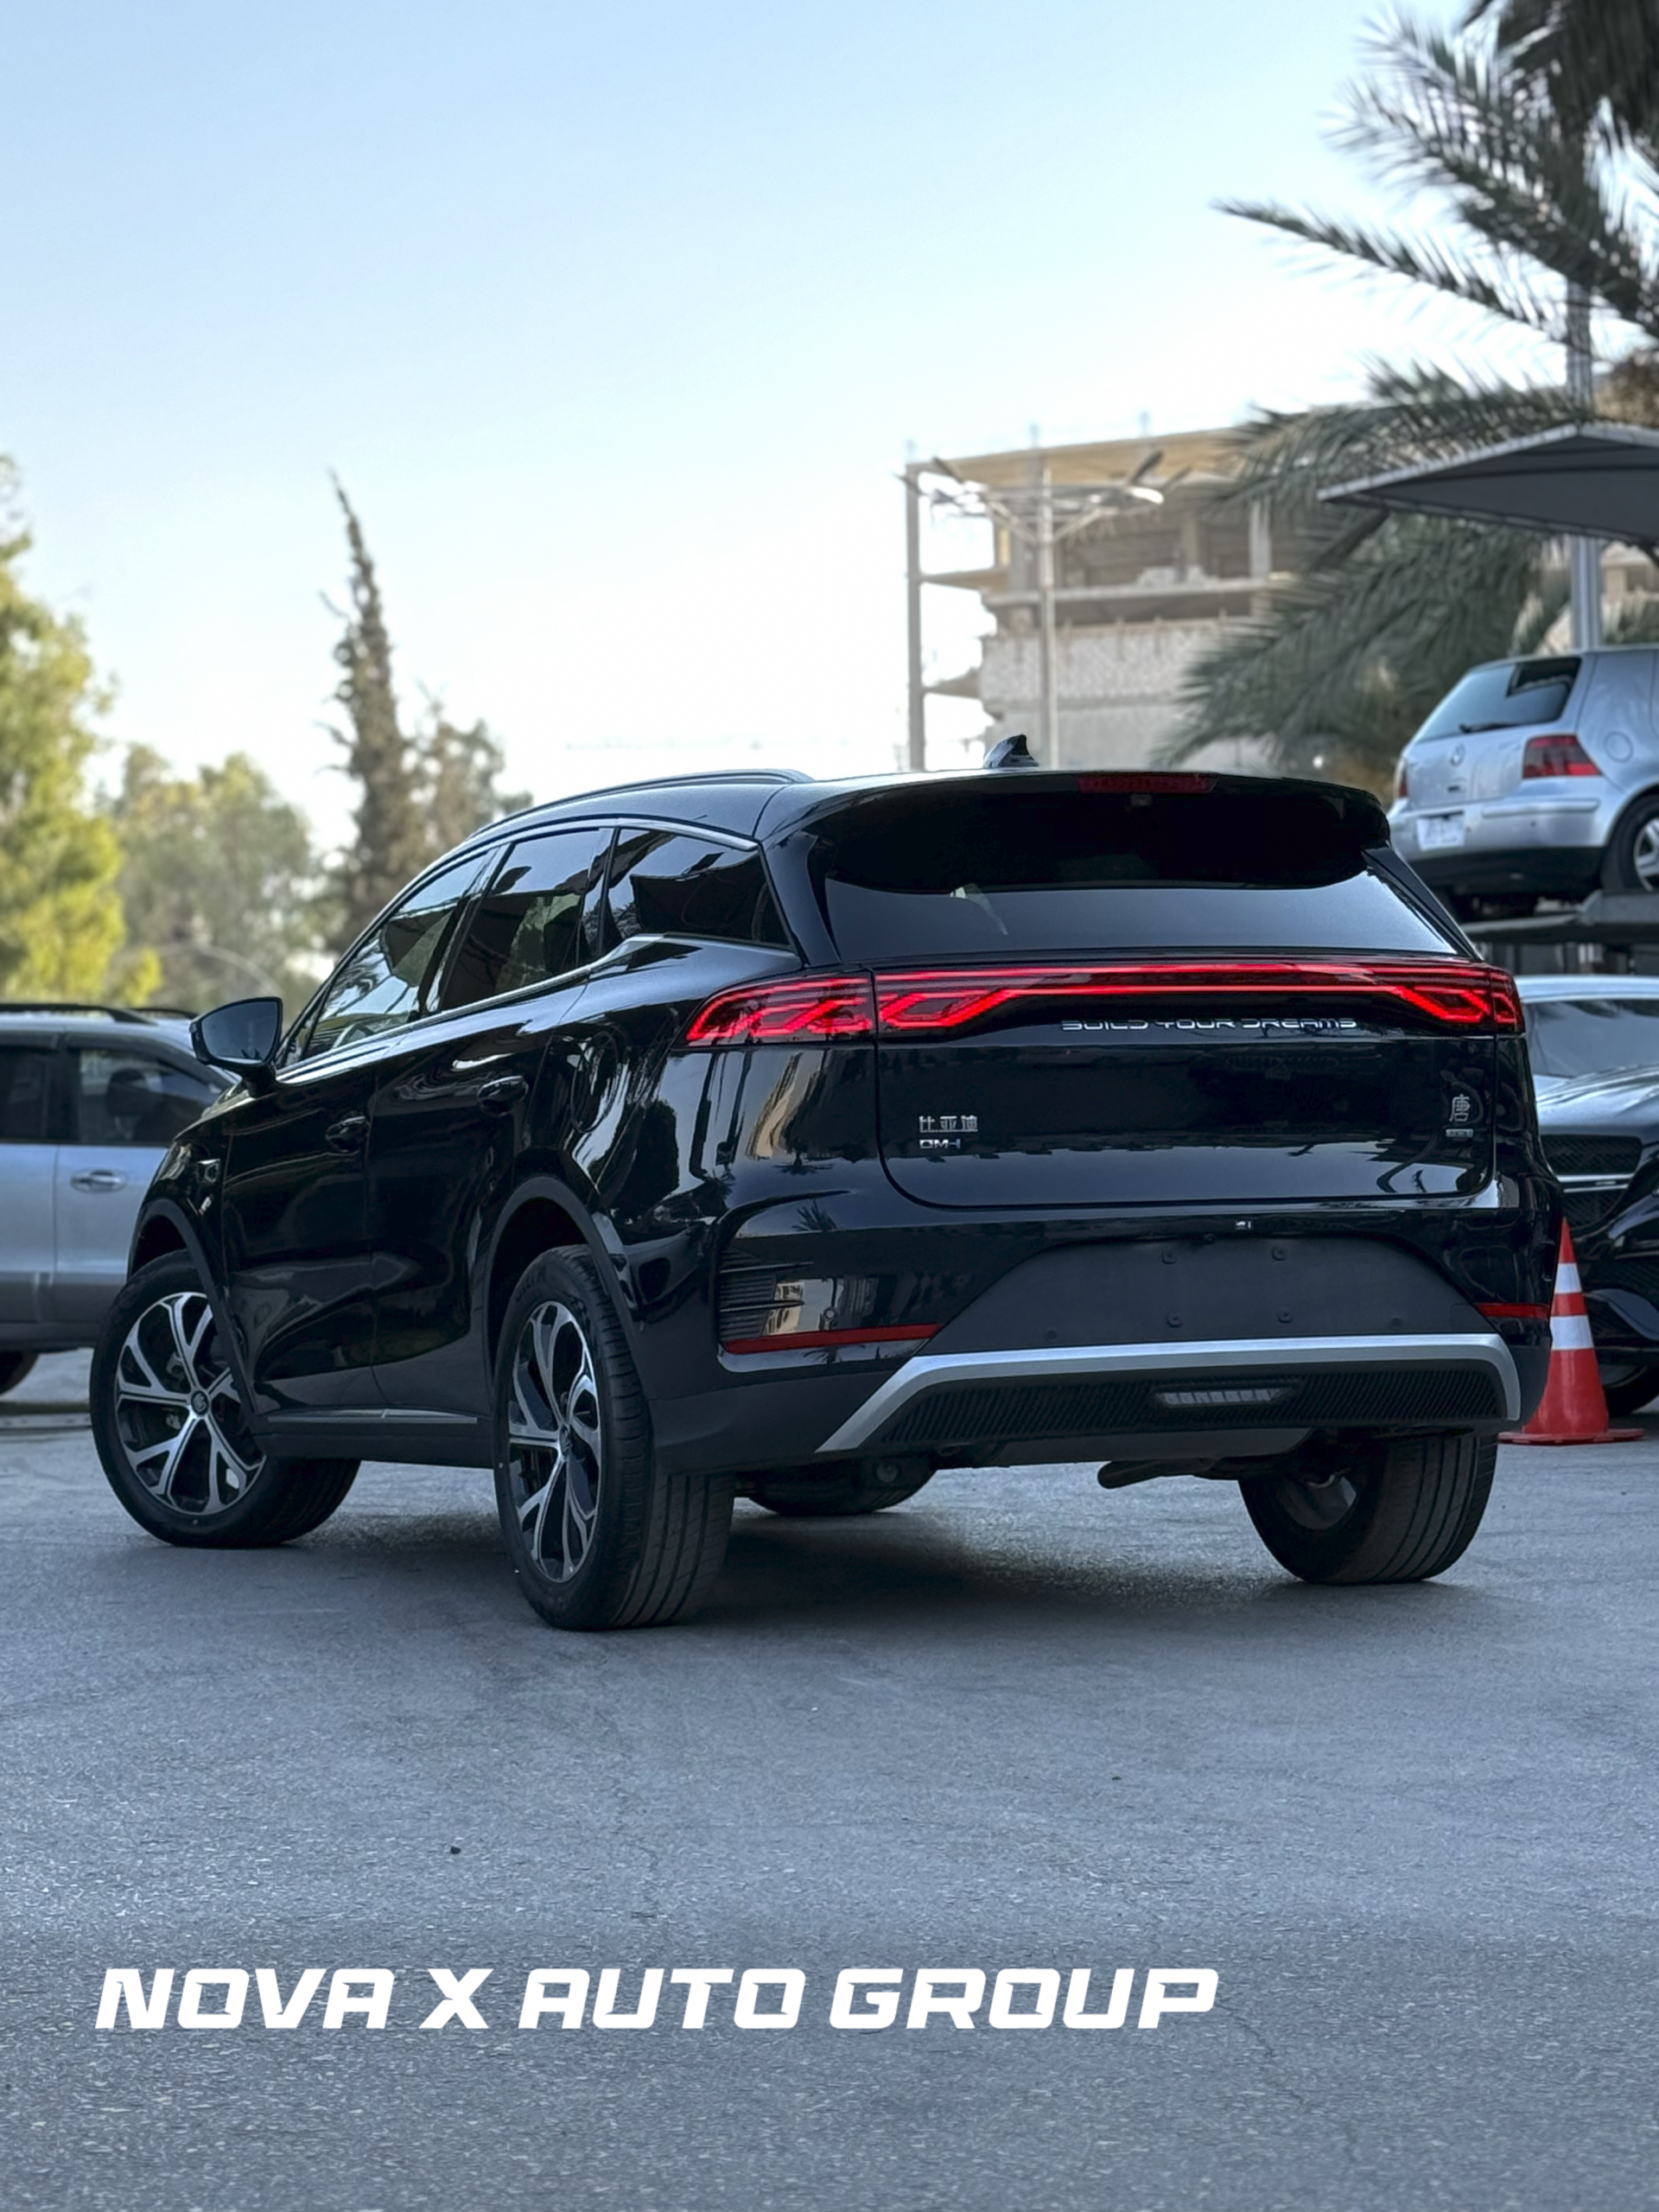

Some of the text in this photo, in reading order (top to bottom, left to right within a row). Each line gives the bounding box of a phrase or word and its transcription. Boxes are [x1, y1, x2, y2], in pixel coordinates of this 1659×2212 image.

[1061, 1018, 1357, 1031] BUILD YOUR DREAMS
[918, 1115, 978, 1133] 比亚迪
